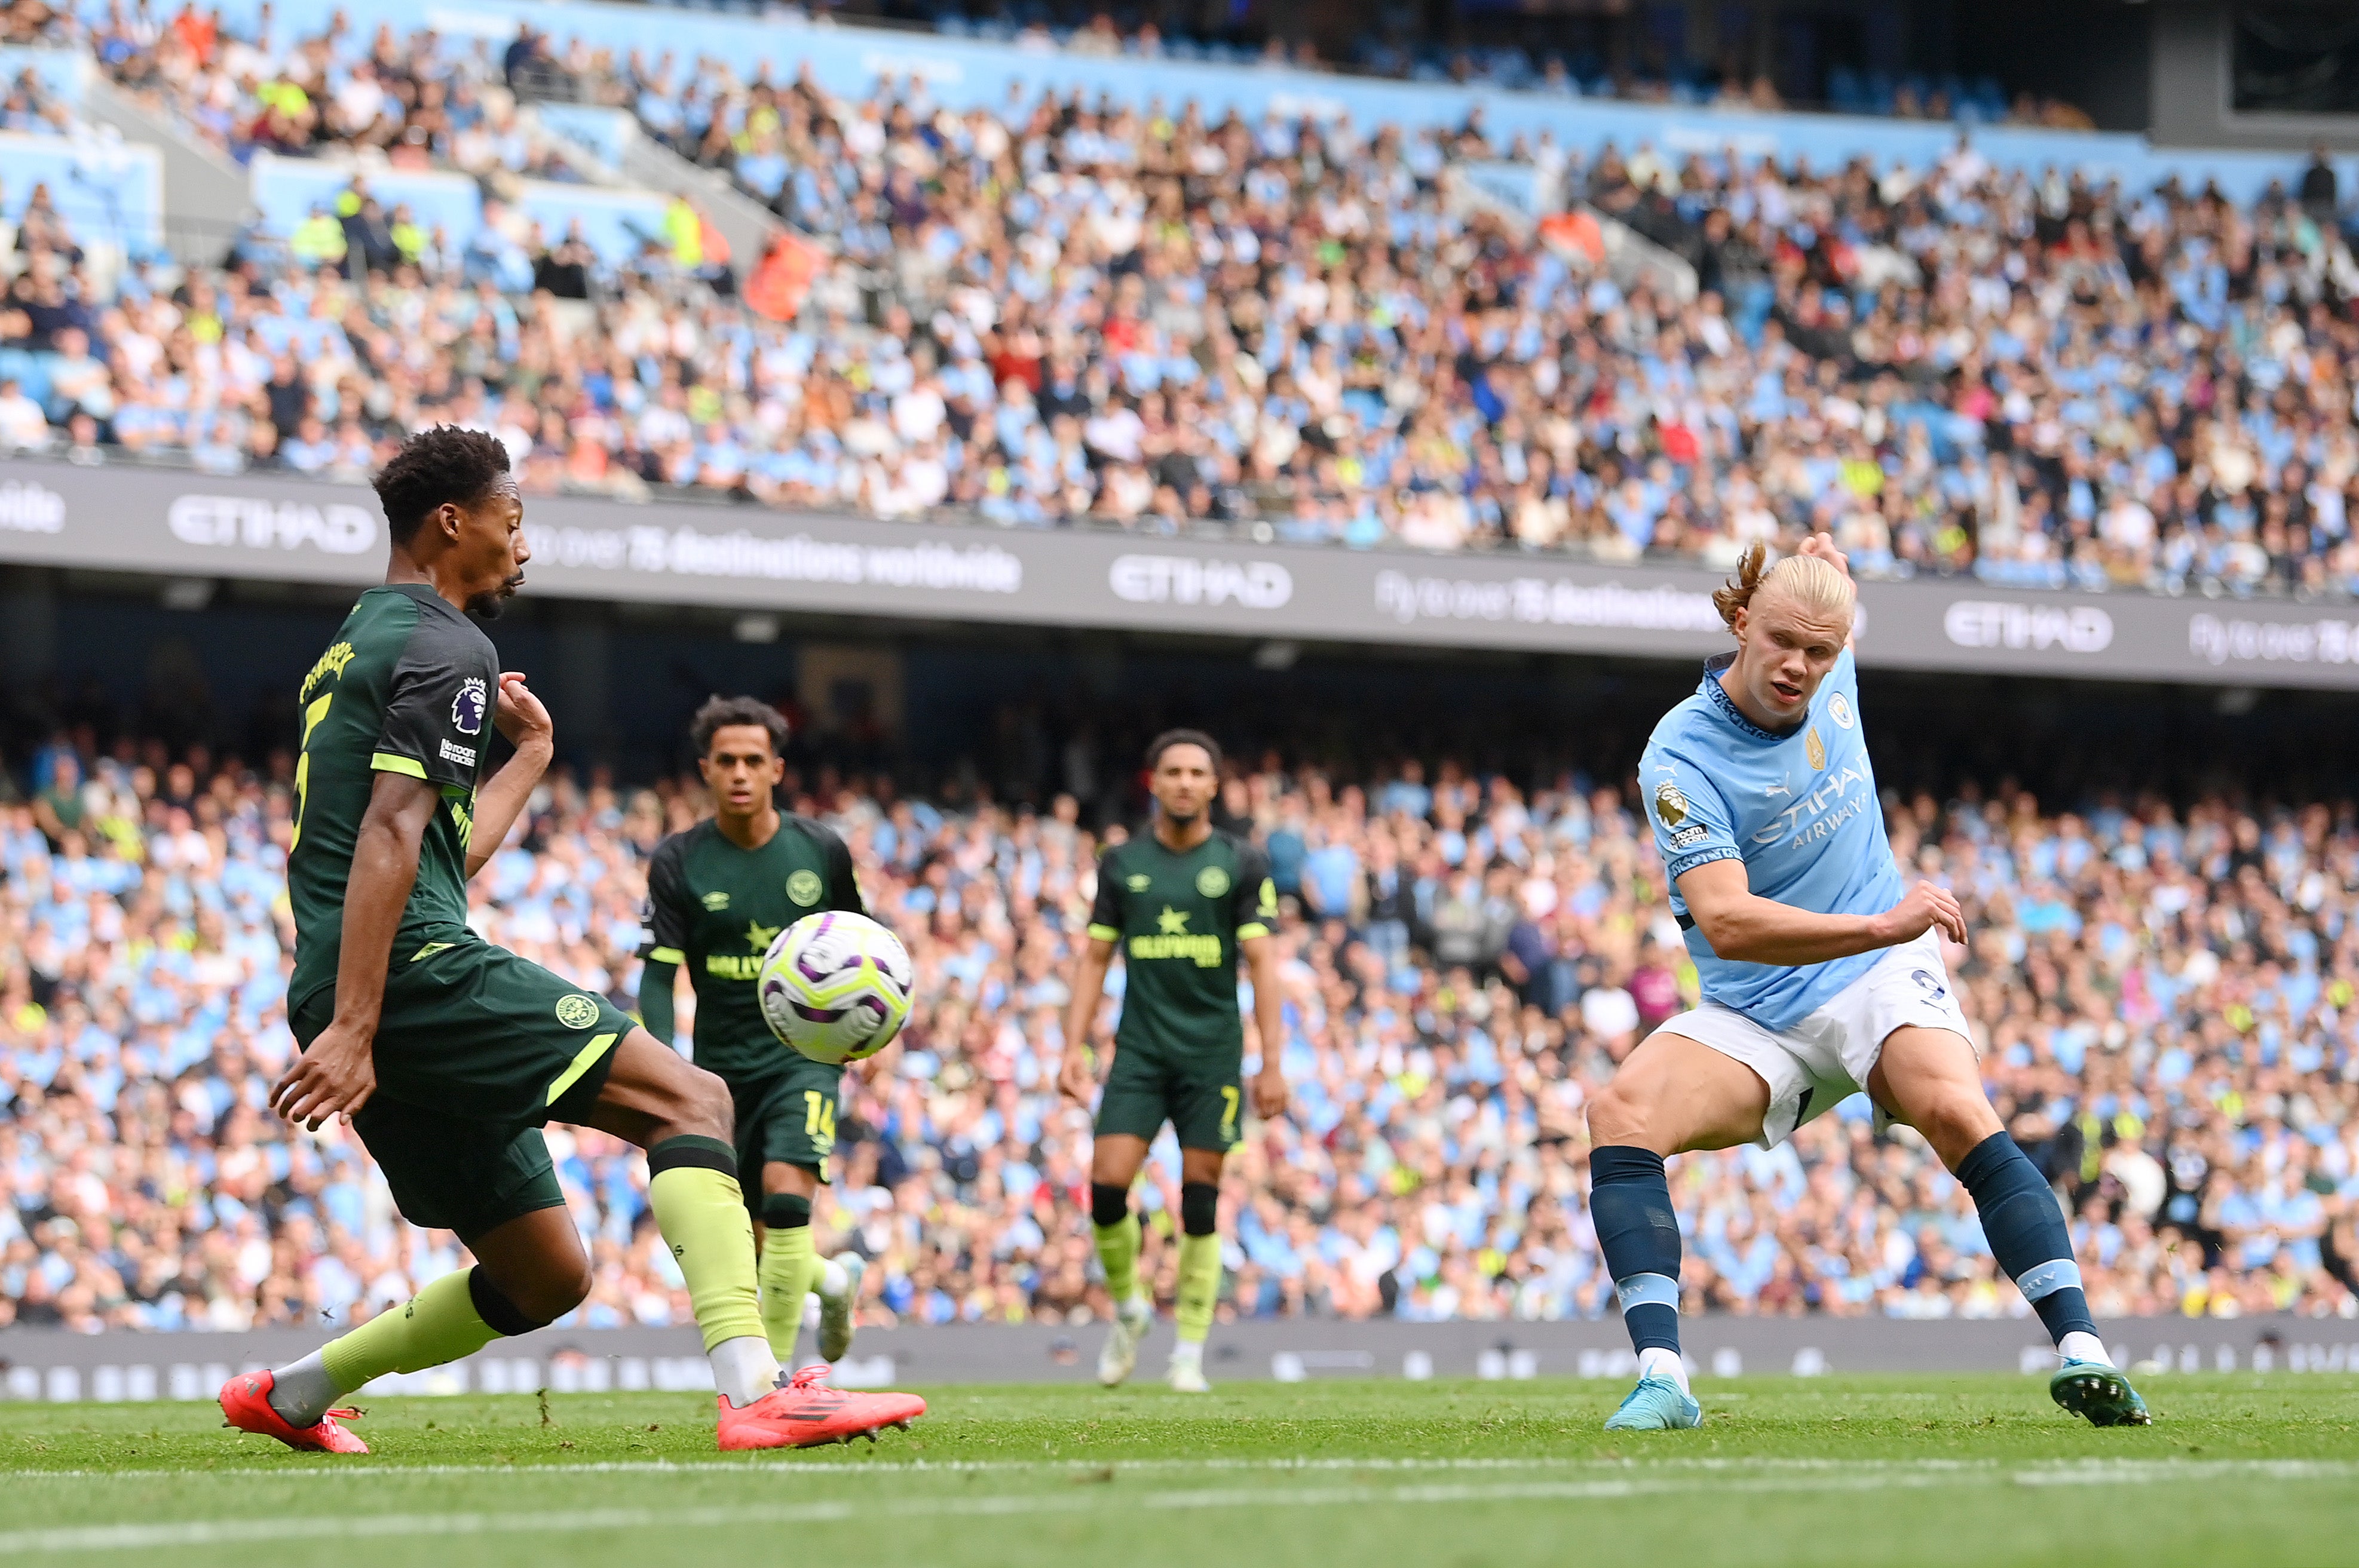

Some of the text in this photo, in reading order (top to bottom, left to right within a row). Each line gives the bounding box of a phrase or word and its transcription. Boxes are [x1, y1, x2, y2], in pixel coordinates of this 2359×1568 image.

[168, 495, 378, 554] ETIHAD
[670, 524, 863, 584] destinations
[1109, 554, 1294, 609] ETIHAD
[1944, 600, 2114, 653] ETIHAD
[1675, 826, 1704, 840] room
[1911, 969, 1945, 1000] 9
[804, 1090, 835, 1141] 14
[1220, 1084, 1240, 1127] 7
